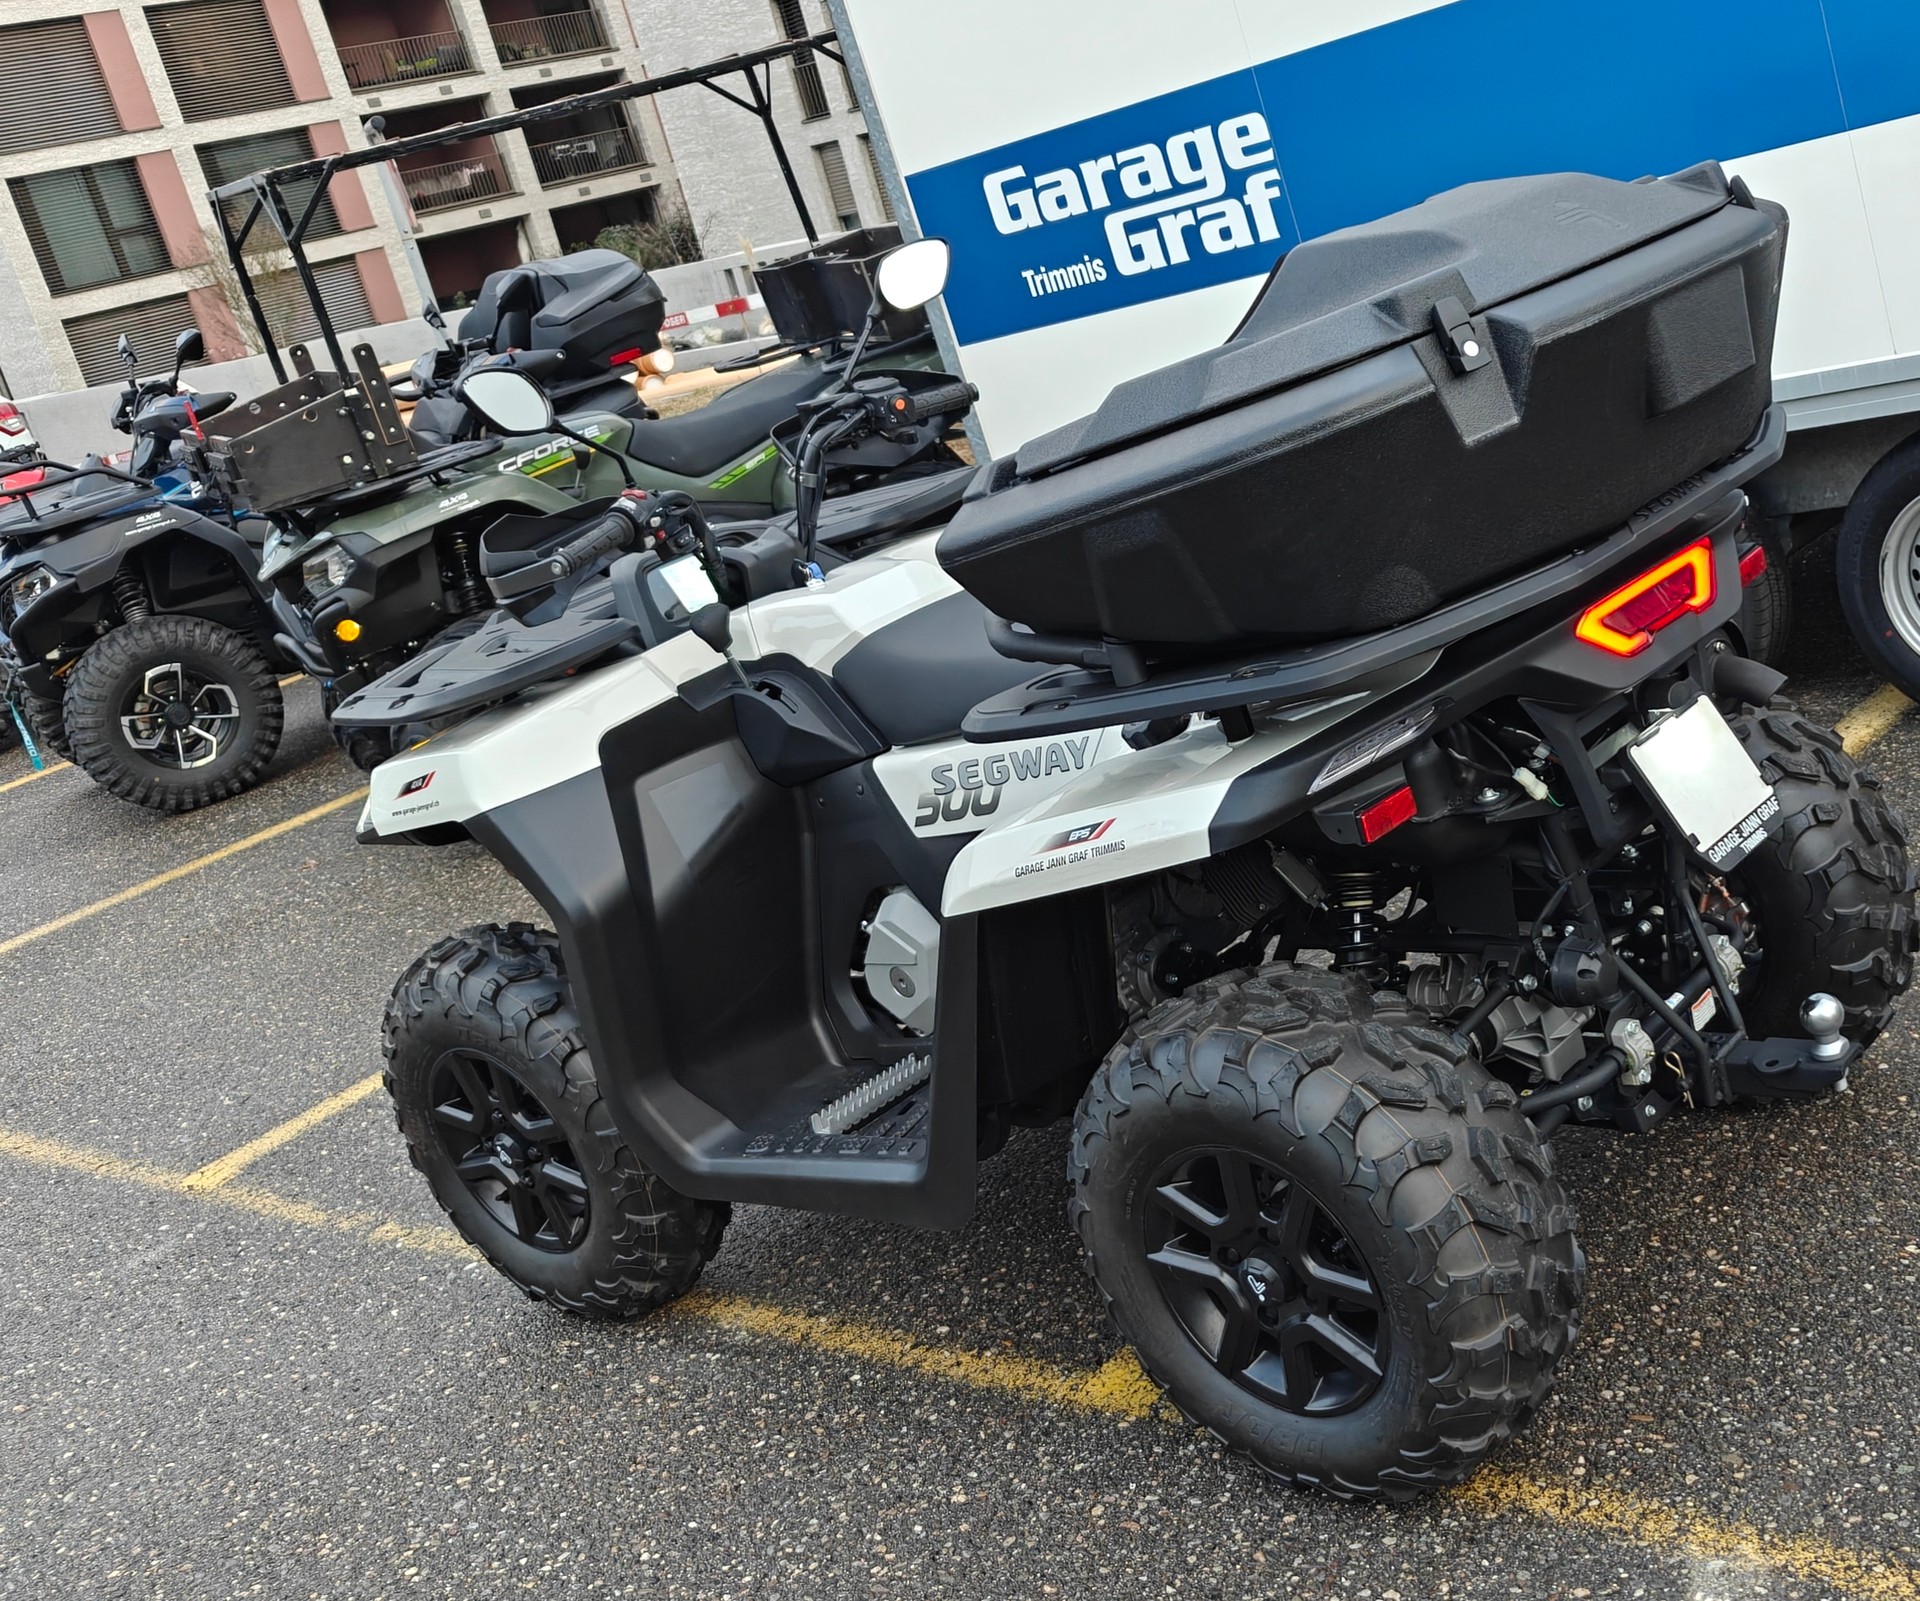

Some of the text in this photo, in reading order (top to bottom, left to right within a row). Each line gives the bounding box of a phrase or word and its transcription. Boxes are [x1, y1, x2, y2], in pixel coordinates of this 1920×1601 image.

[983, 112, 1275, 235] Garage
[1104, 168, 1281, 277] Graf
[1021, 254, 1108, 298] Trimmis
[1634, 473, 1707, 521] SEGWAY
[931, 736, 1090, 795] SEGWAY
[914, 783, 1004, 828] 500
[1068, 827, 1091, 842] EPS
[1708, 796, 1779, 863] GARAGE JANN GRAF
[1740, 827, 1768, 854] TRIMMIS
[1015, 840, 1126, 878] GARAGE JANN GRAF TRIMMIS
